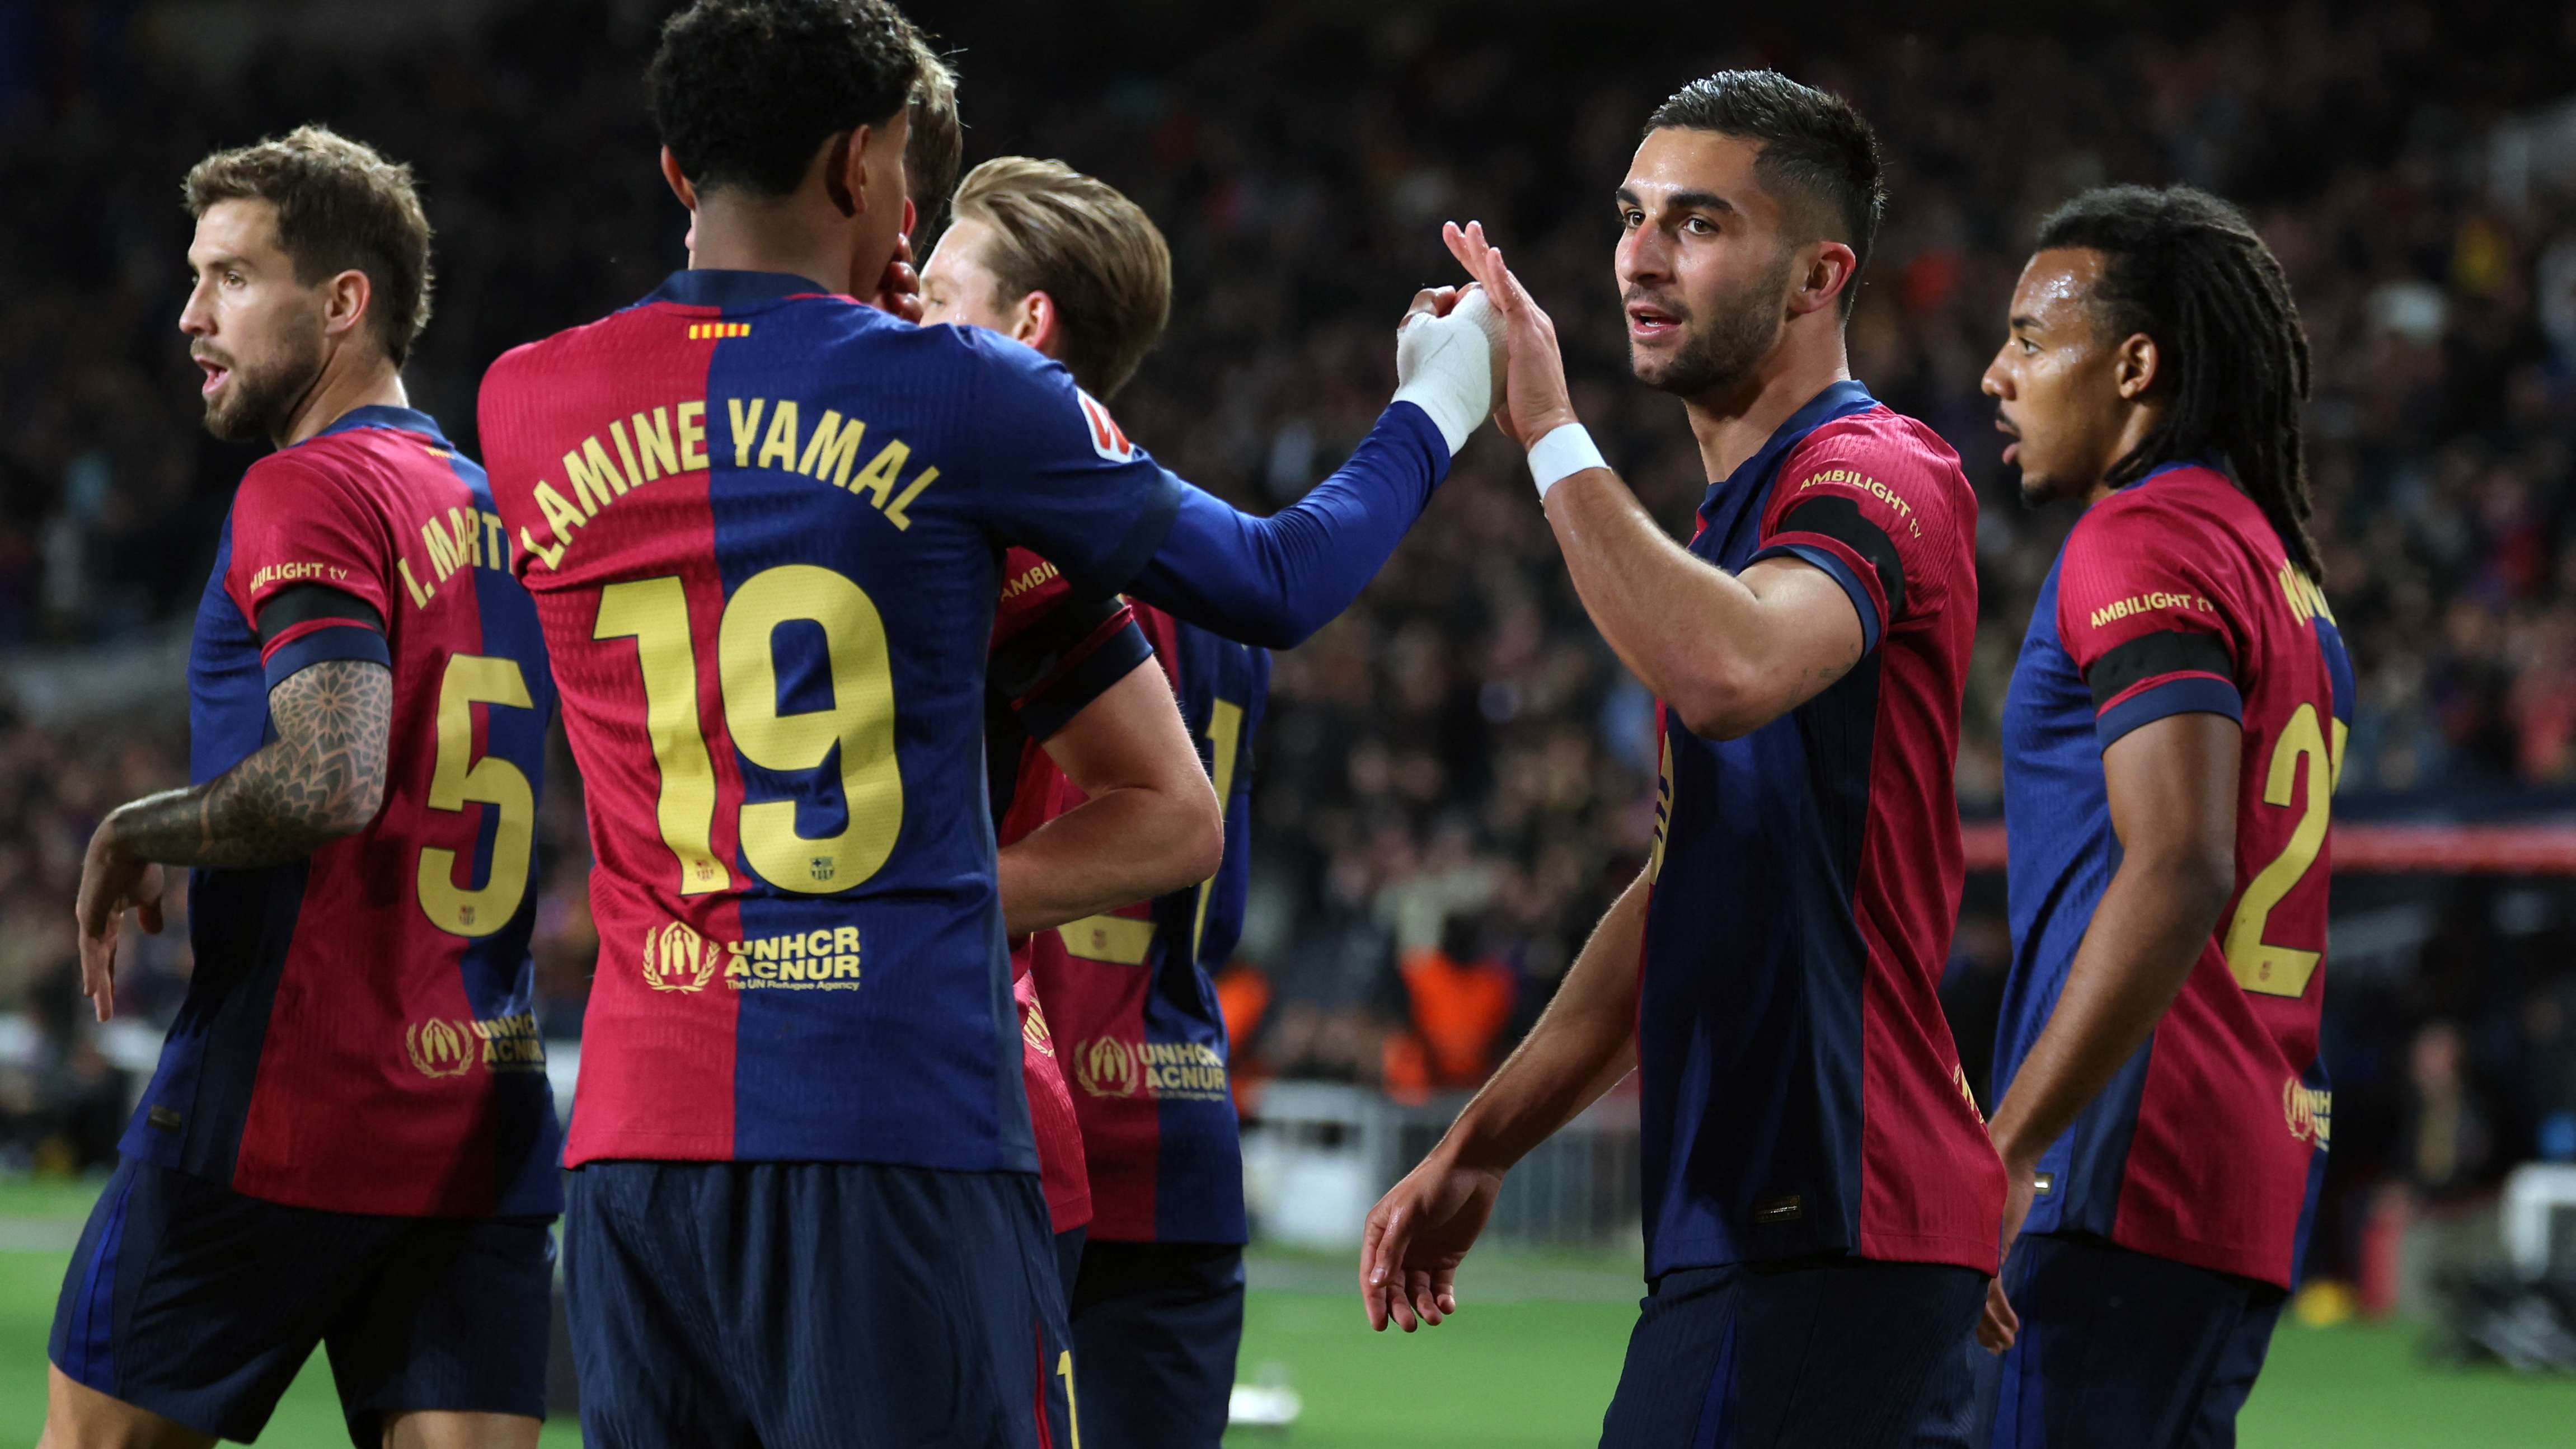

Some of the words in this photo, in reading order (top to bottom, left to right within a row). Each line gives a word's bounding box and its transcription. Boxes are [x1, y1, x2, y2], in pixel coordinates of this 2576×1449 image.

[520, 400, 710, 570] LAMINE
[728, 398, 940, 532] YAMAL
[1800, 470, 1911, 518] AMBILIGHT
[1909, 517, 1921, 539] tv
[329, 566, 347, 580] tv
[397, 557, 435, 610] I.
[421, 506, 513, 583] MART
[2091, 592, 2192, 629] AMBILIGHT
[592, 564, 903, 895] 19
[416, 652, 534, 937] 5
[2223, 701, 2349, 998] 2
[724, 954, 861, 981] ACNUR
[727, 926, 861, 961] UNHCR
[726, 979, 746, 990] The
[747, 979, 766, 990] UN
[767, 980, 815, 991] Refugee
[817, 981, 860, 991] Agency
[1146, 1065, 1226, 1091] ACNUR
